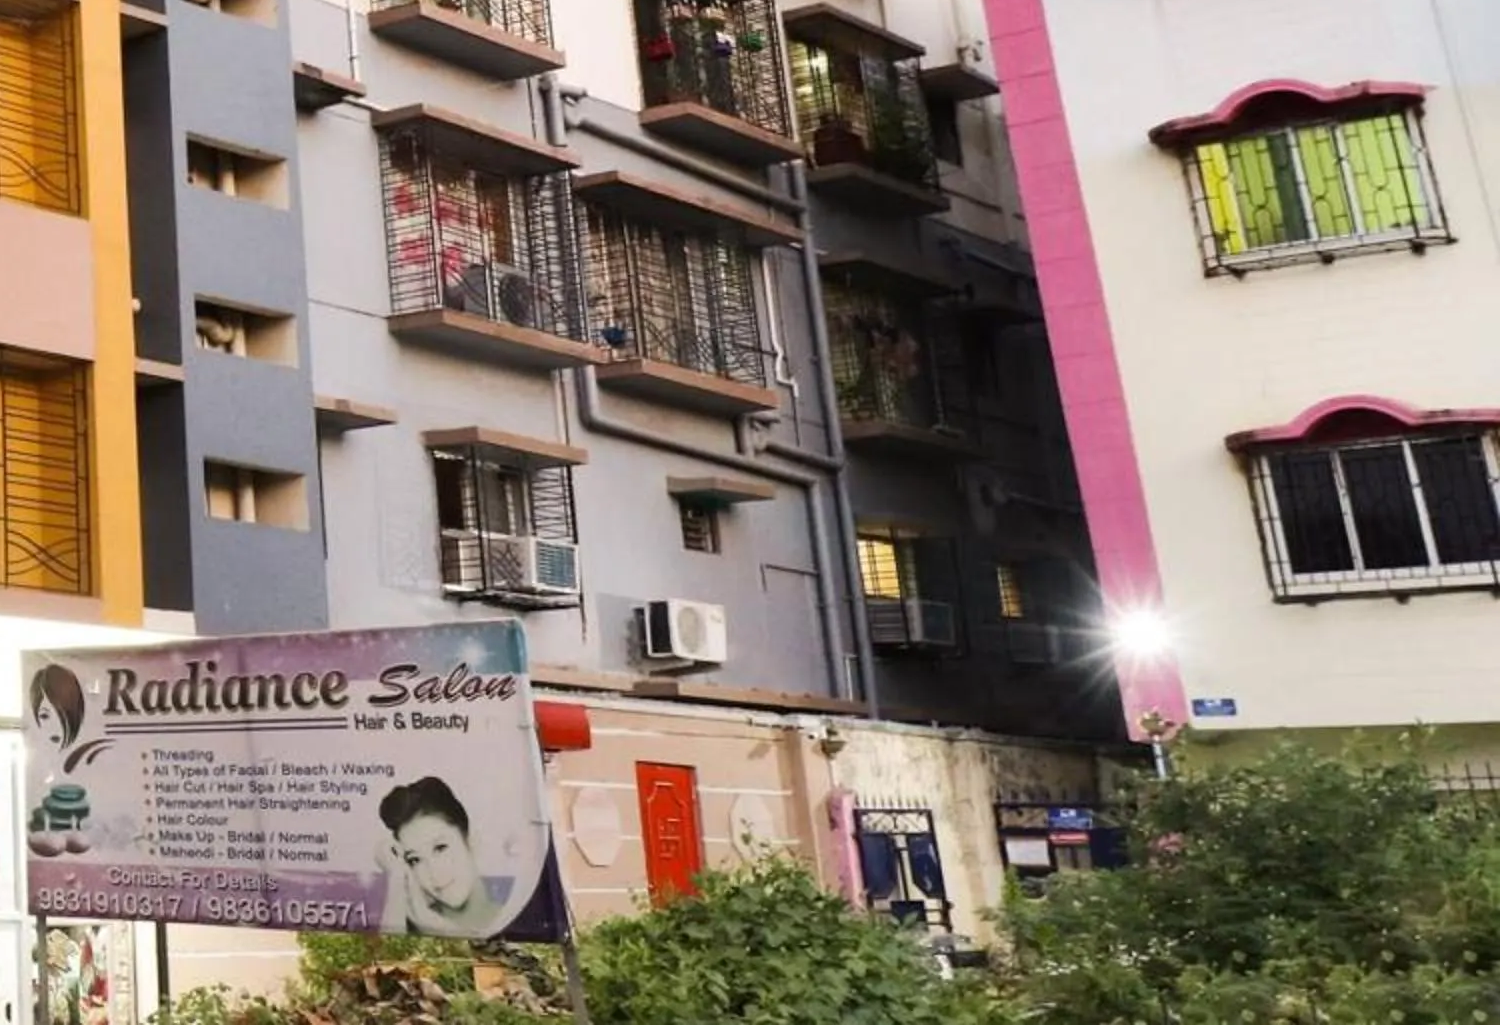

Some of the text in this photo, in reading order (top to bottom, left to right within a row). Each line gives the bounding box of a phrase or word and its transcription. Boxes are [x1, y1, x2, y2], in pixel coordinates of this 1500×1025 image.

[103, 660, 517, 715] Radiance Salon
[354, 712, 469, 733] Hair & Beauty
[152, 749, 214, 763] Threading
[153, 764, 169, 776] All
[173, 764, 209, 779] Types
[213, 764, 226, 776] of
[229, 764, 269, 776] Facial
[281, 763, 329, 776] Bleach
[341, 763, 395, 777] Waxing
[155, 782, 180, 793] Hair
[183, 780, 206, 793] Cut
[217, 781, 243, 793] Hair
[247, 780, 275, 795] Spa
[287, 780, 315, 793] Hair
[319, 780, 367, 795] Styling
[155, 797, 350, 812] Permanent Hair Straightening
[157, 814, 229, 826] Hair Colour
[158, 830, 194, 842] Make
[195, 830, 215, 844] Up
[227, 830, 266, 843] Bridal
[278, 831, 329, 844] Normal
[159, 846, 215, 859] Mehendi
[227, 846, 266, 860] Bridal
[277, 848, 329, 862] Normal
[107, 867, 279, 892] Contact For Details
[38, 887, 182, 917] 9831910317
[207, 897, 369, 928] 9836105571
